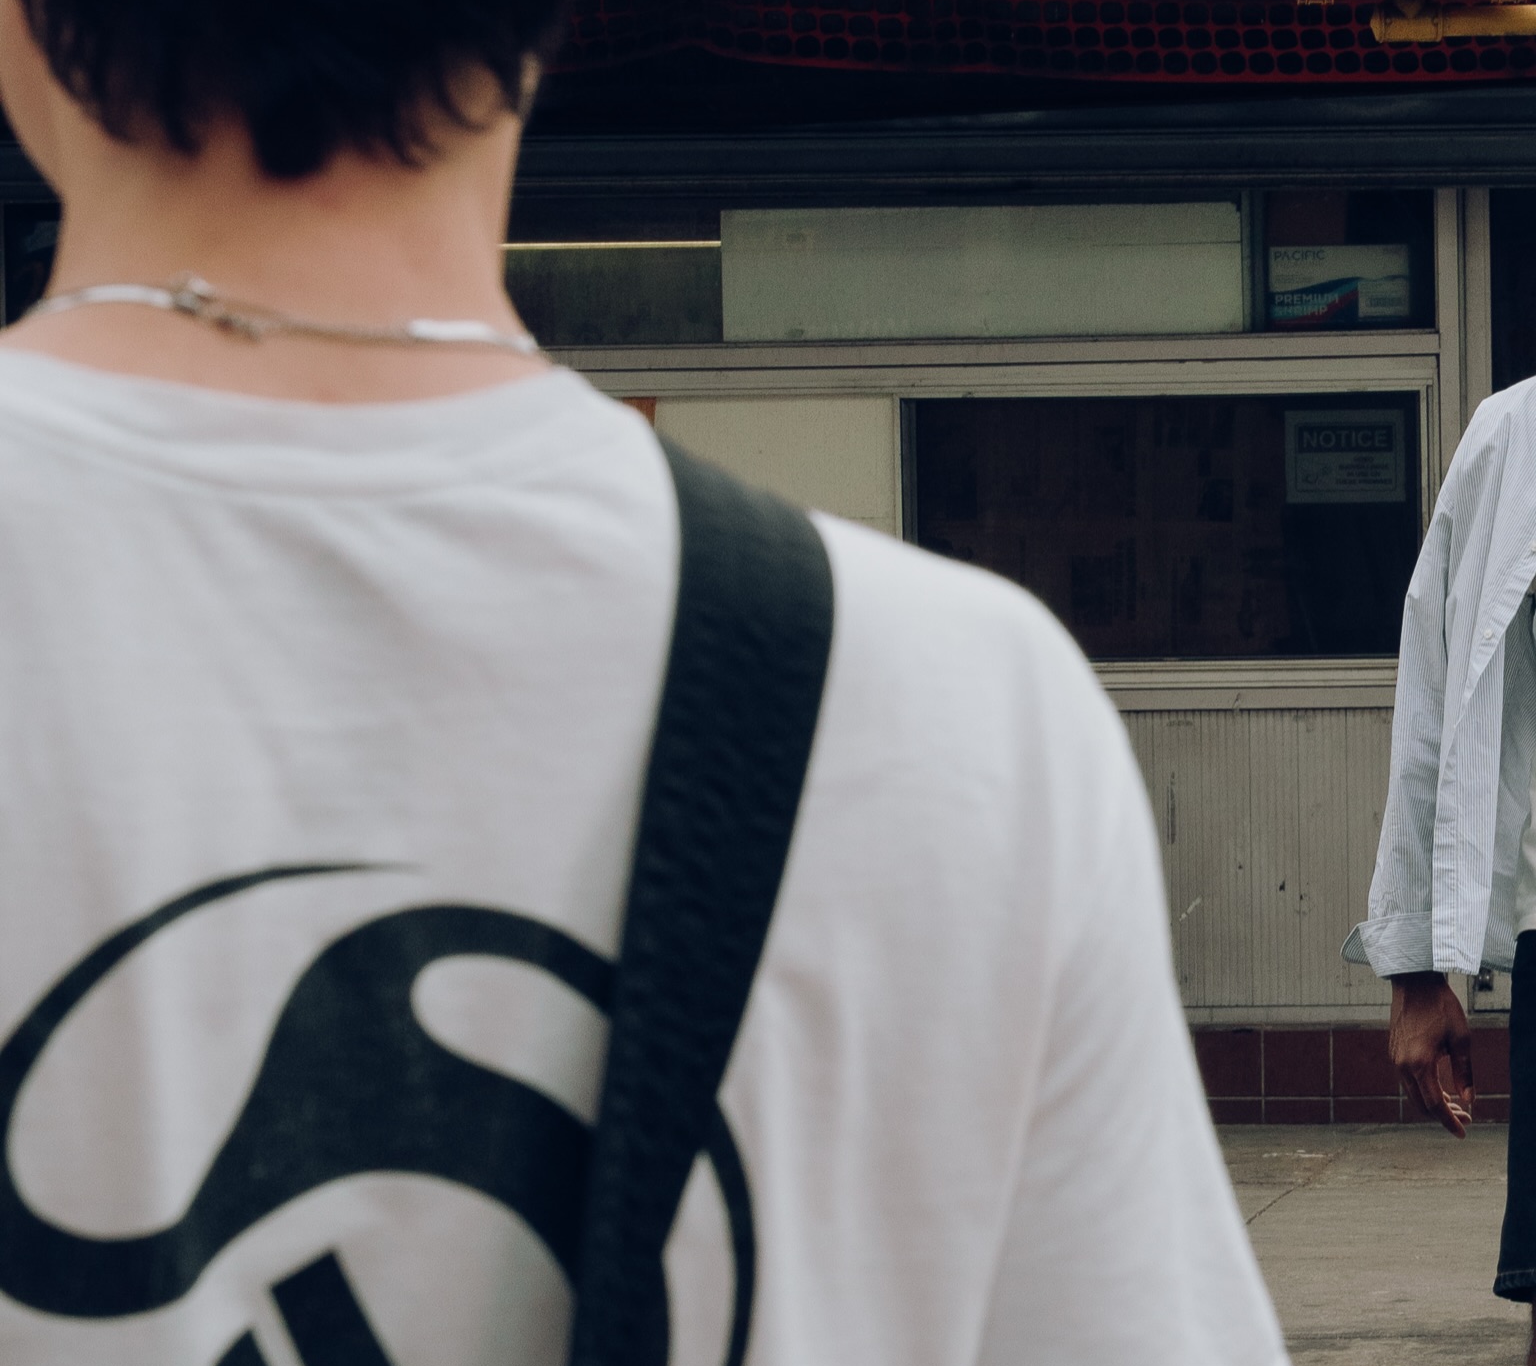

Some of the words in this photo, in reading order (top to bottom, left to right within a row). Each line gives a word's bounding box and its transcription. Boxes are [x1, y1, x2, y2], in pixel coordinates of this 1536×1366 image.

[1273, 249, 1326, 262] PACIFIC
[1274, 292, 1339, 305] PREMIUM
[1303, 429, 1388, 449] NOTICE
